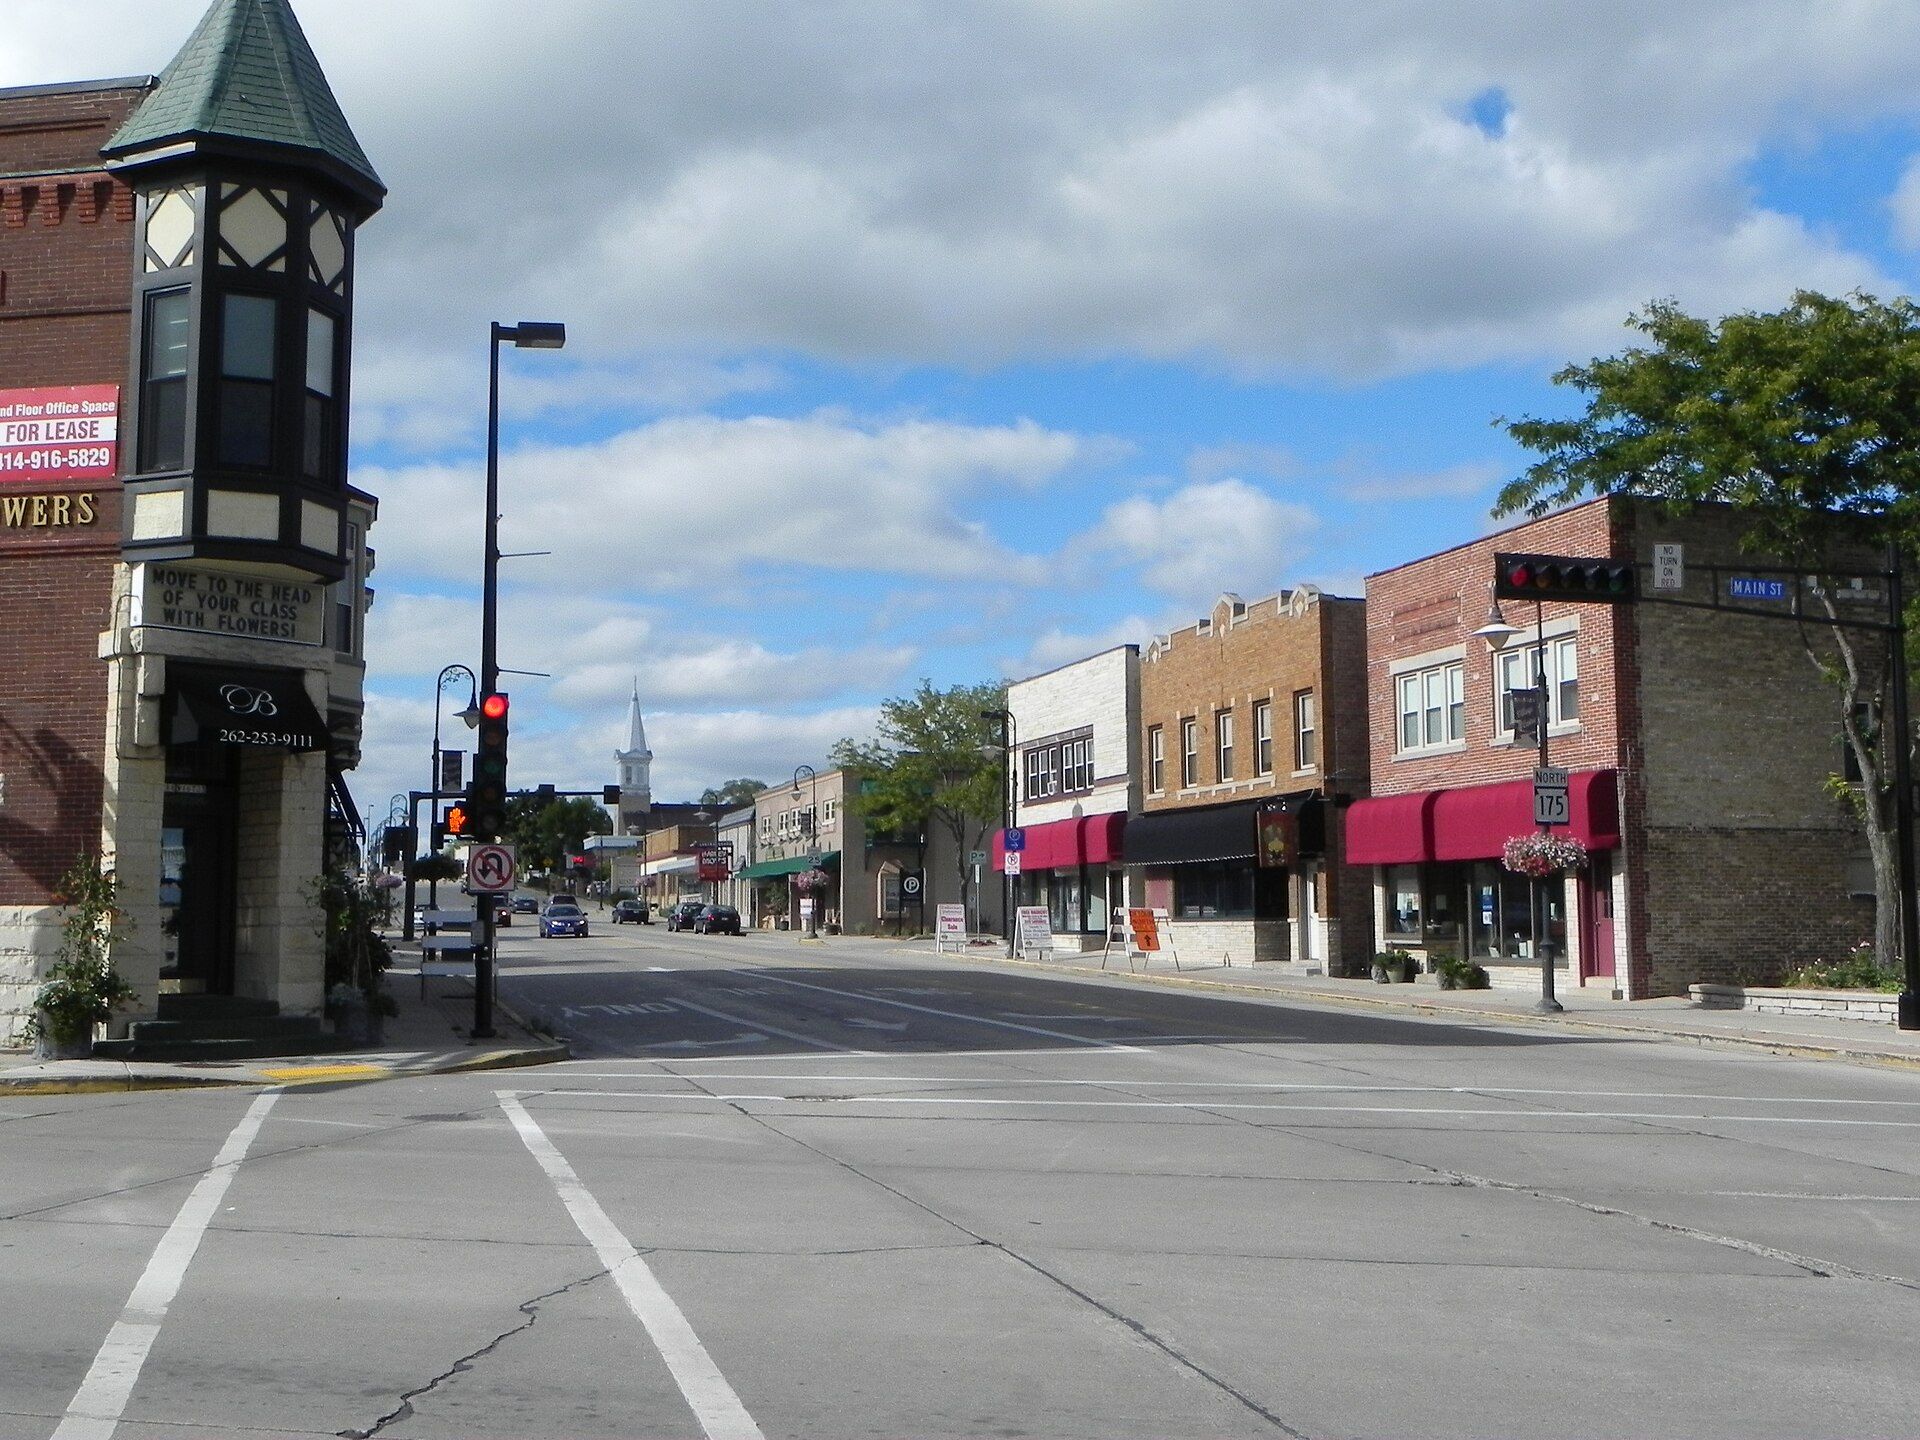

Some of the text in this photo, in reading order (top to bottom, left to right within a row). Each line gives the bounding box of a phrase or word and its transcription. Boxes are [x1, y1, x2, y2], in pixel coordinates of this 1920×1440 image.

[15, 403, 44, 417] Floor
[45, 402, 79, 415] Office
[81, 400, 116, 415] Space
[6, 420, 99, 442] FOR LEASE
[2, 493, 94, 527] WERS
[1663, 546, 1673, 555] NO
[1659, 556, 1678, 565] TURN
[1663, 567, 1673, 577] ON
[152, 568, 311, 604] MOVE TO THE HEAD
[1734, 580, 1782, 595] MAIN ST
[163, 590, 298, 621] OF YOUR CLASS
[163, 607, 296, 638] WITH FLOWERS!
[219, 729, 312, 747] 262-253-9111
[1535, 770, 1566, 784] NORTH
[1540, 795, 1564, 816] 175
[808, 856, 821, 864] 25
[970, 852, 978, 862] P
